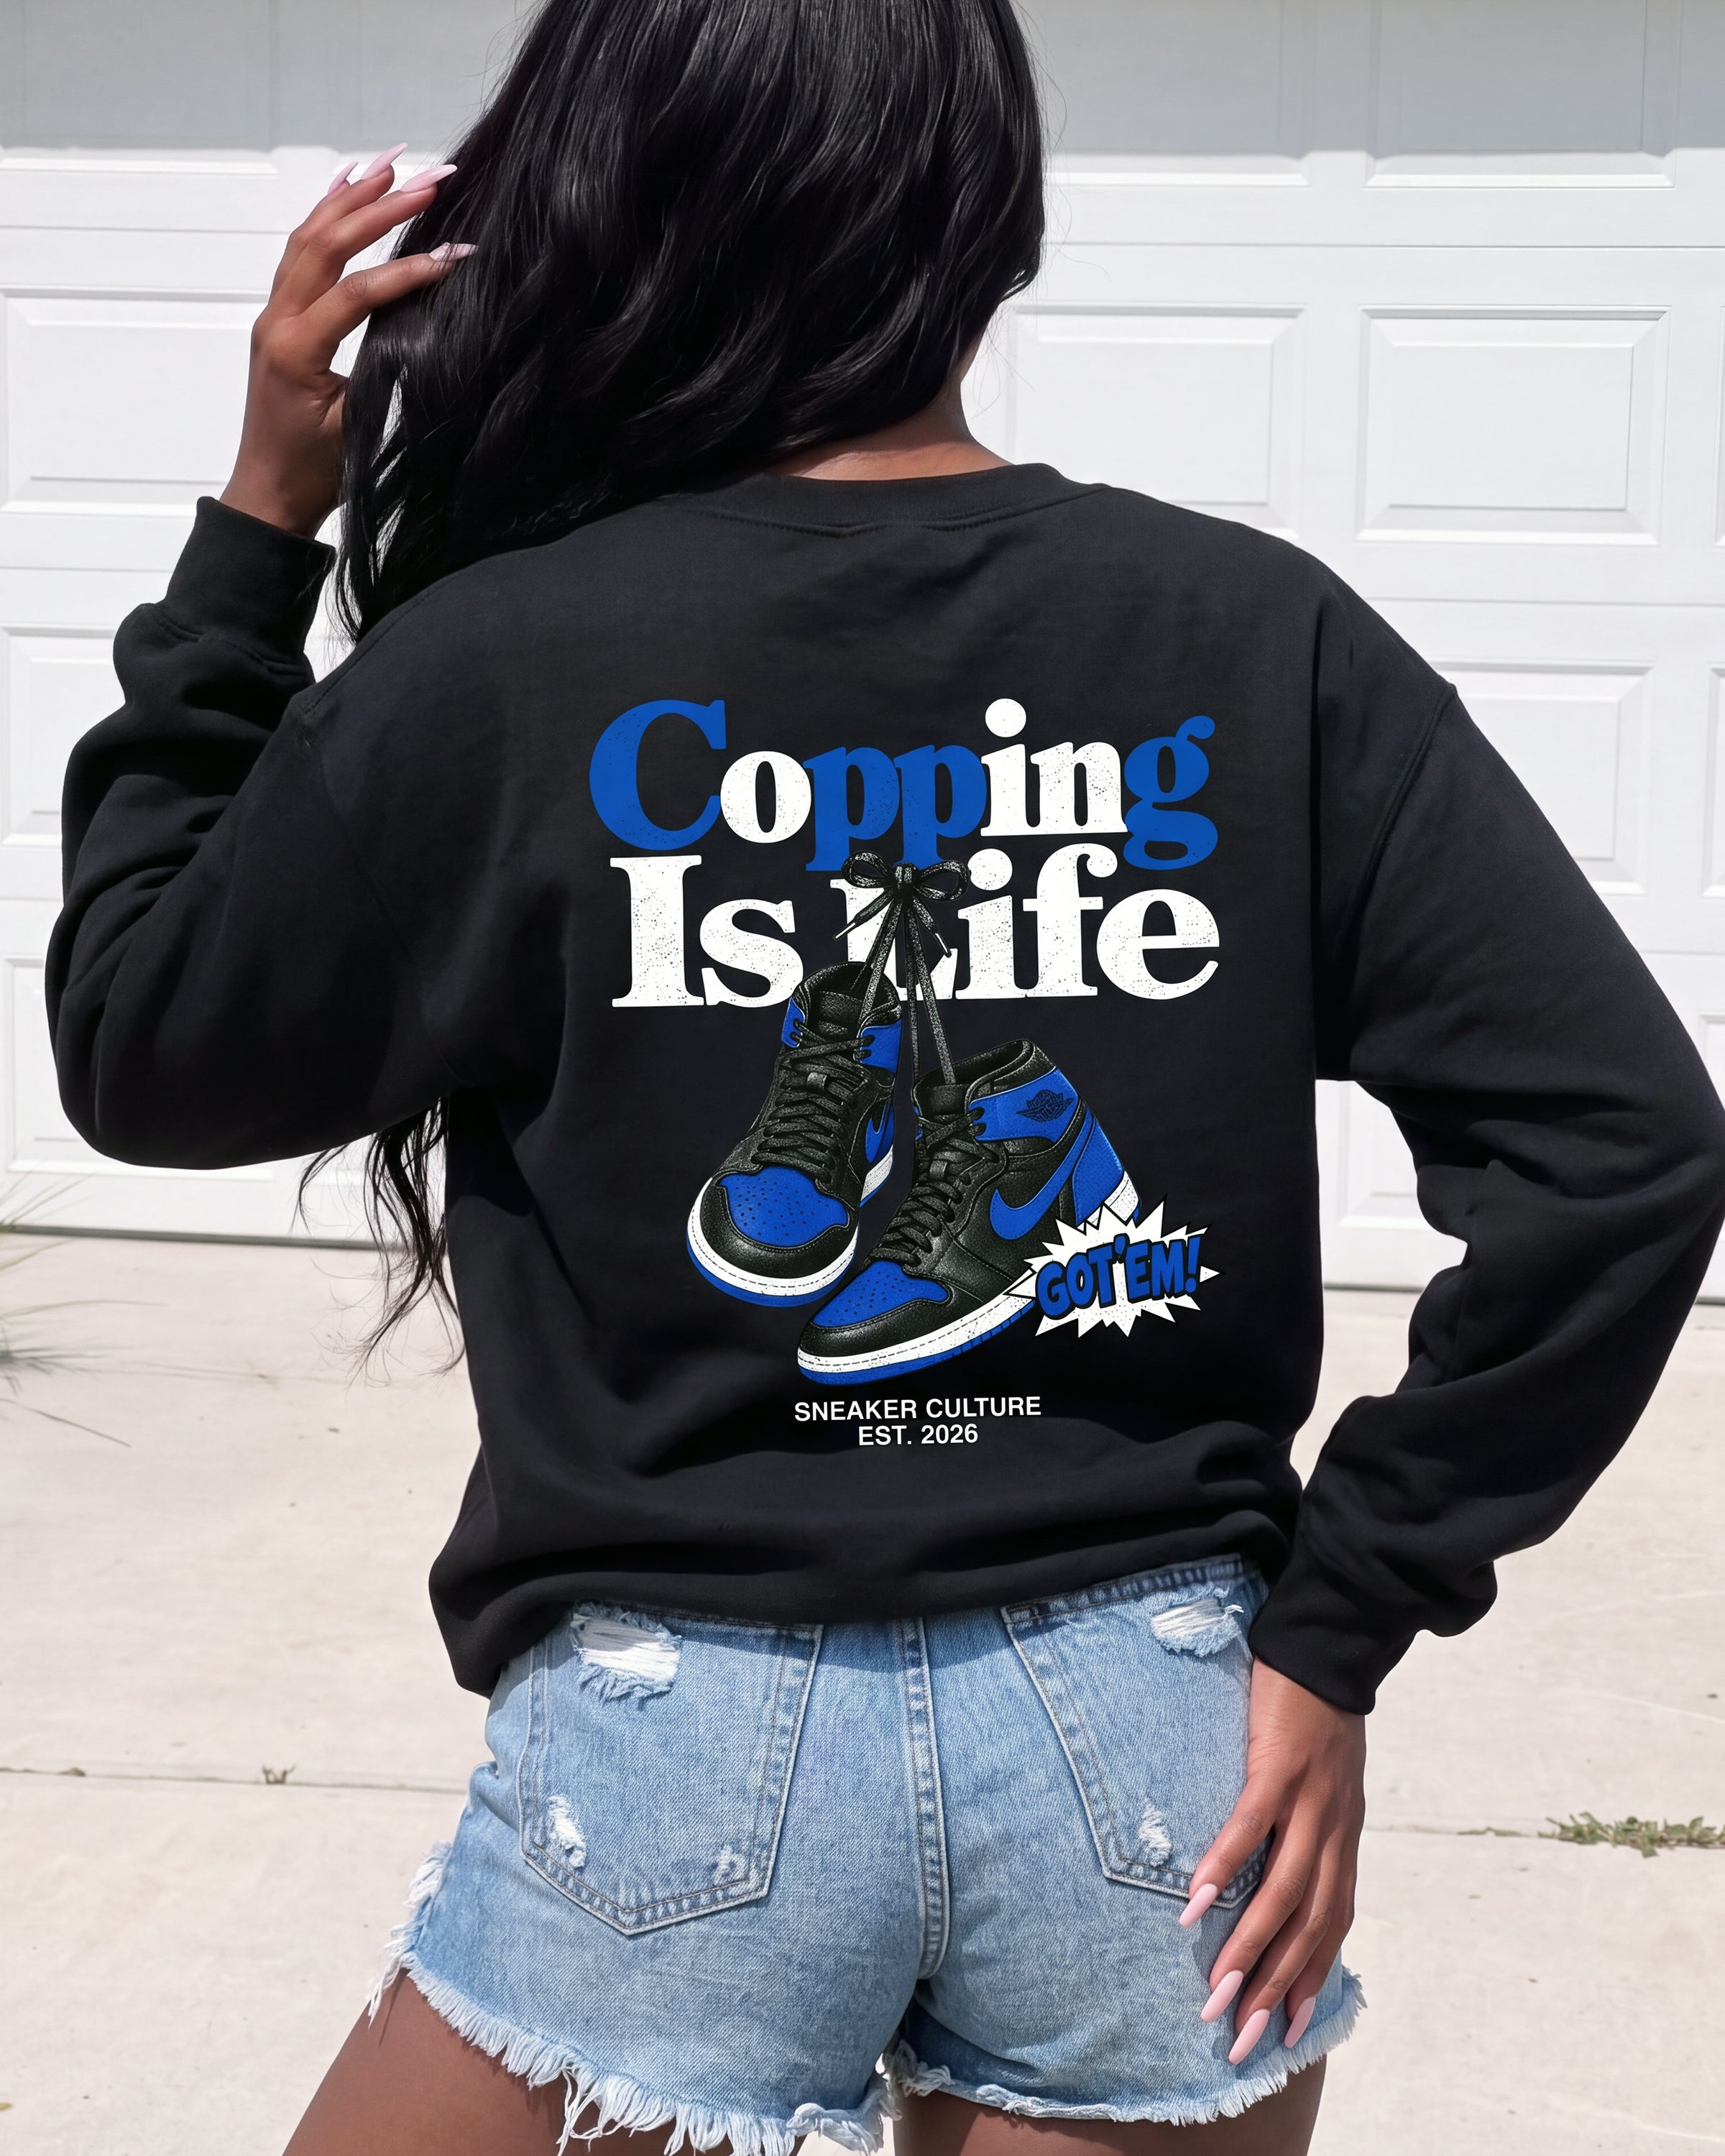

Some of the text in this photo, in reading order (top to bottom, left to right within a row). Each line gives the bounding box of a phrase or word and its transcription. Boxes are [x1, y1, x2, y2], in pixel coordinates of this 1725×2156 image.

[589, 698, 1218, 870] Copping
[610, 854, 804, 1008] Is
[794, 1396, 1041, 1422] SNEAKER CULTURE
[858, 1423, 978, 1446] EST. 2026
